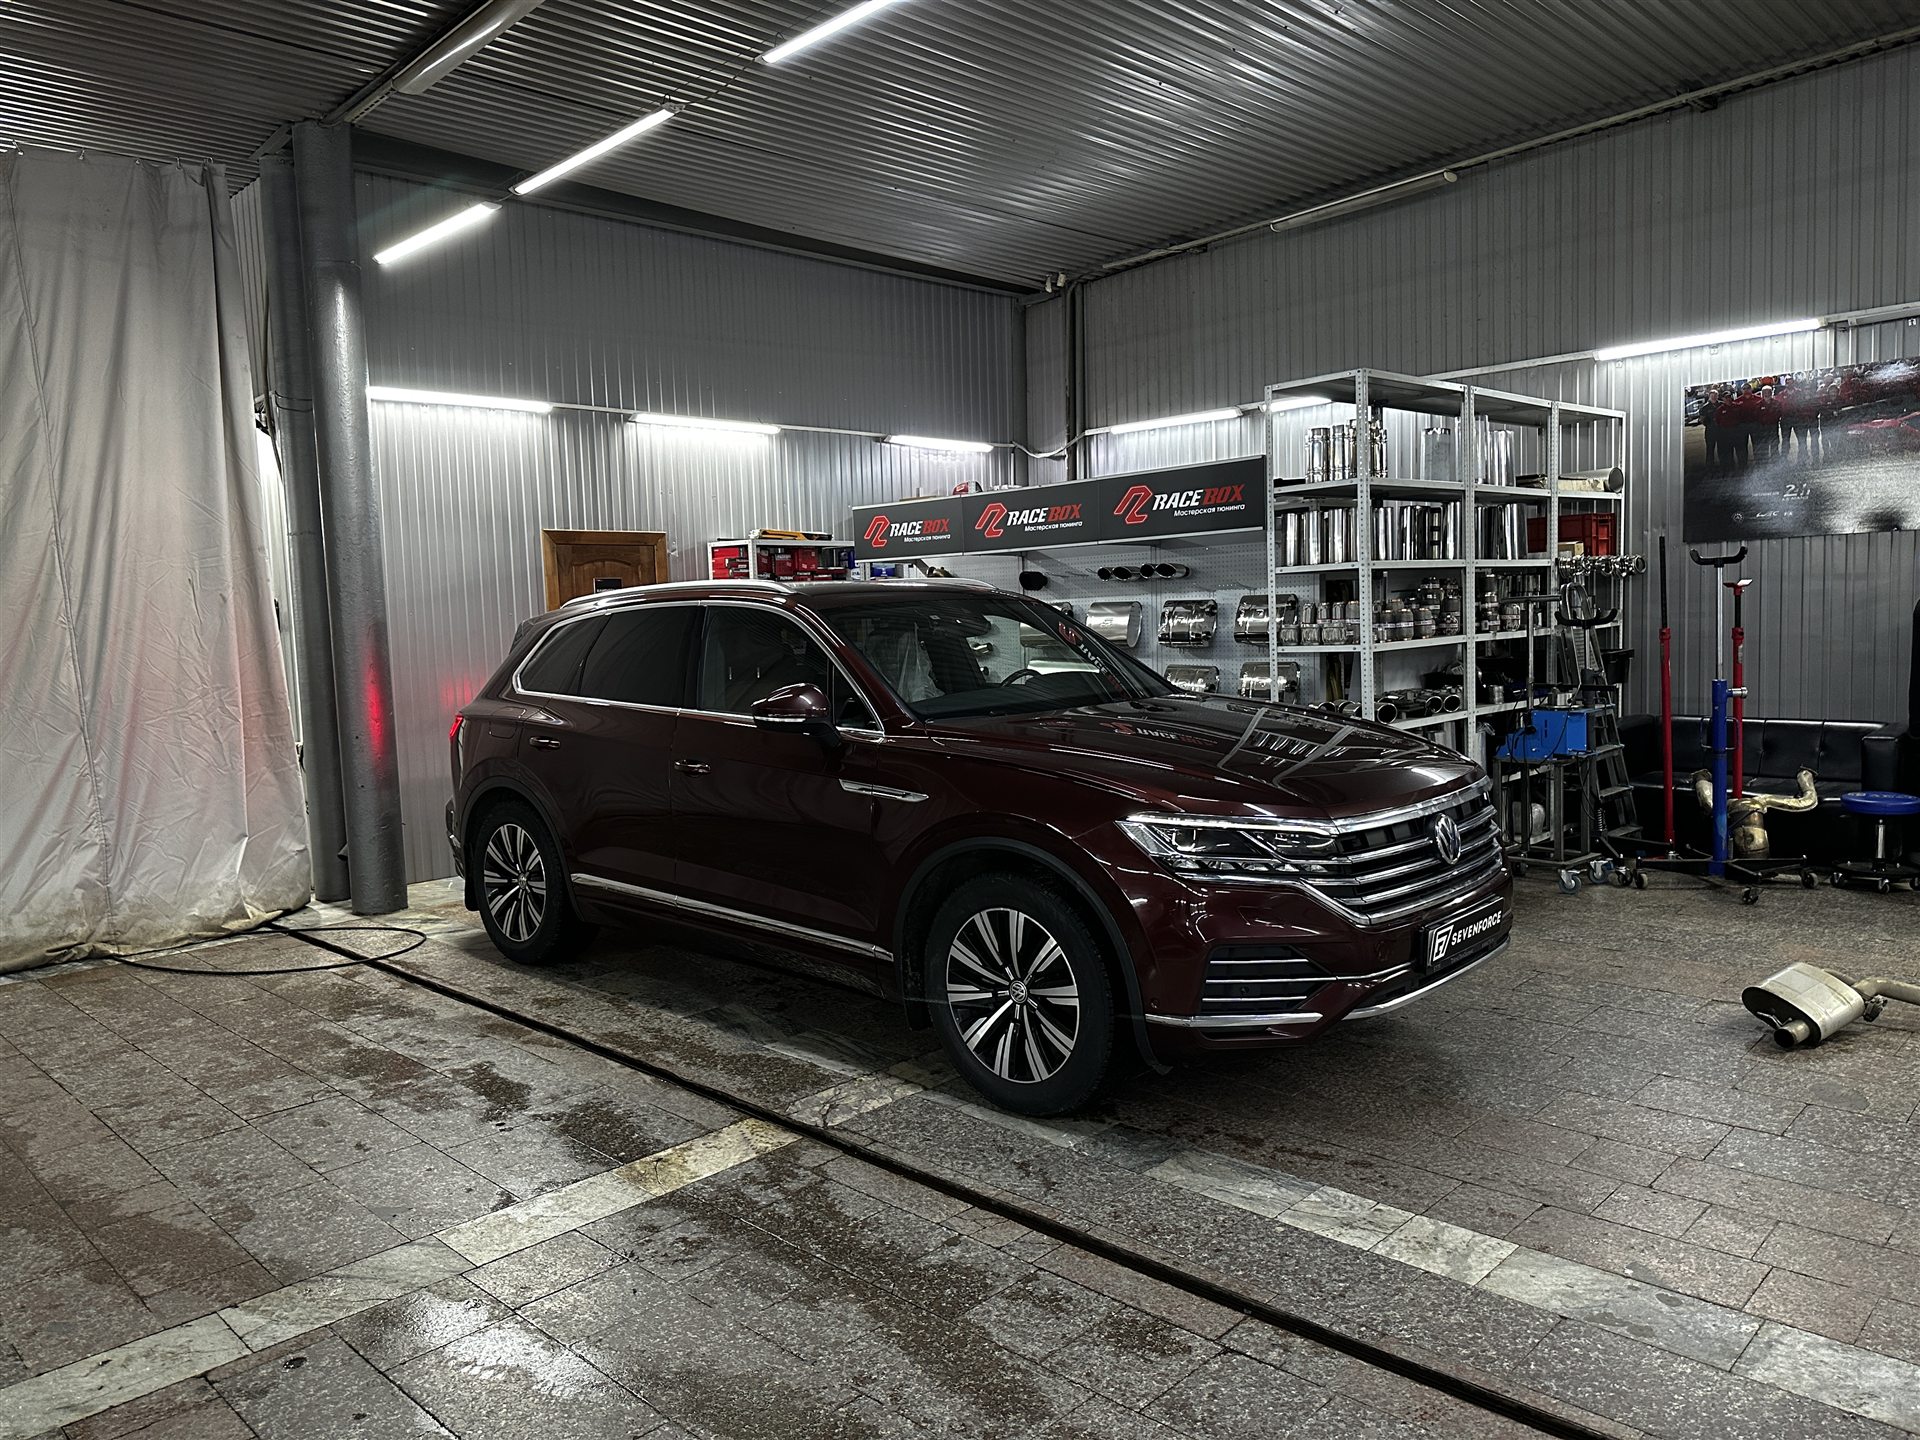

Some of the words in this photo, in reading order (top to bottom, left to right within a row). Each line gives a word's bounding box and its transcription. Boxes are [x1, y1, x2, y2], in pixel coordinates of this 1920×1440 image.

[1173, 507, 1216, 517] Мастерская
[1215, 503, 1246, 513] тюнинга
[1451, 910, 1502, 946] SEVENFORCE
